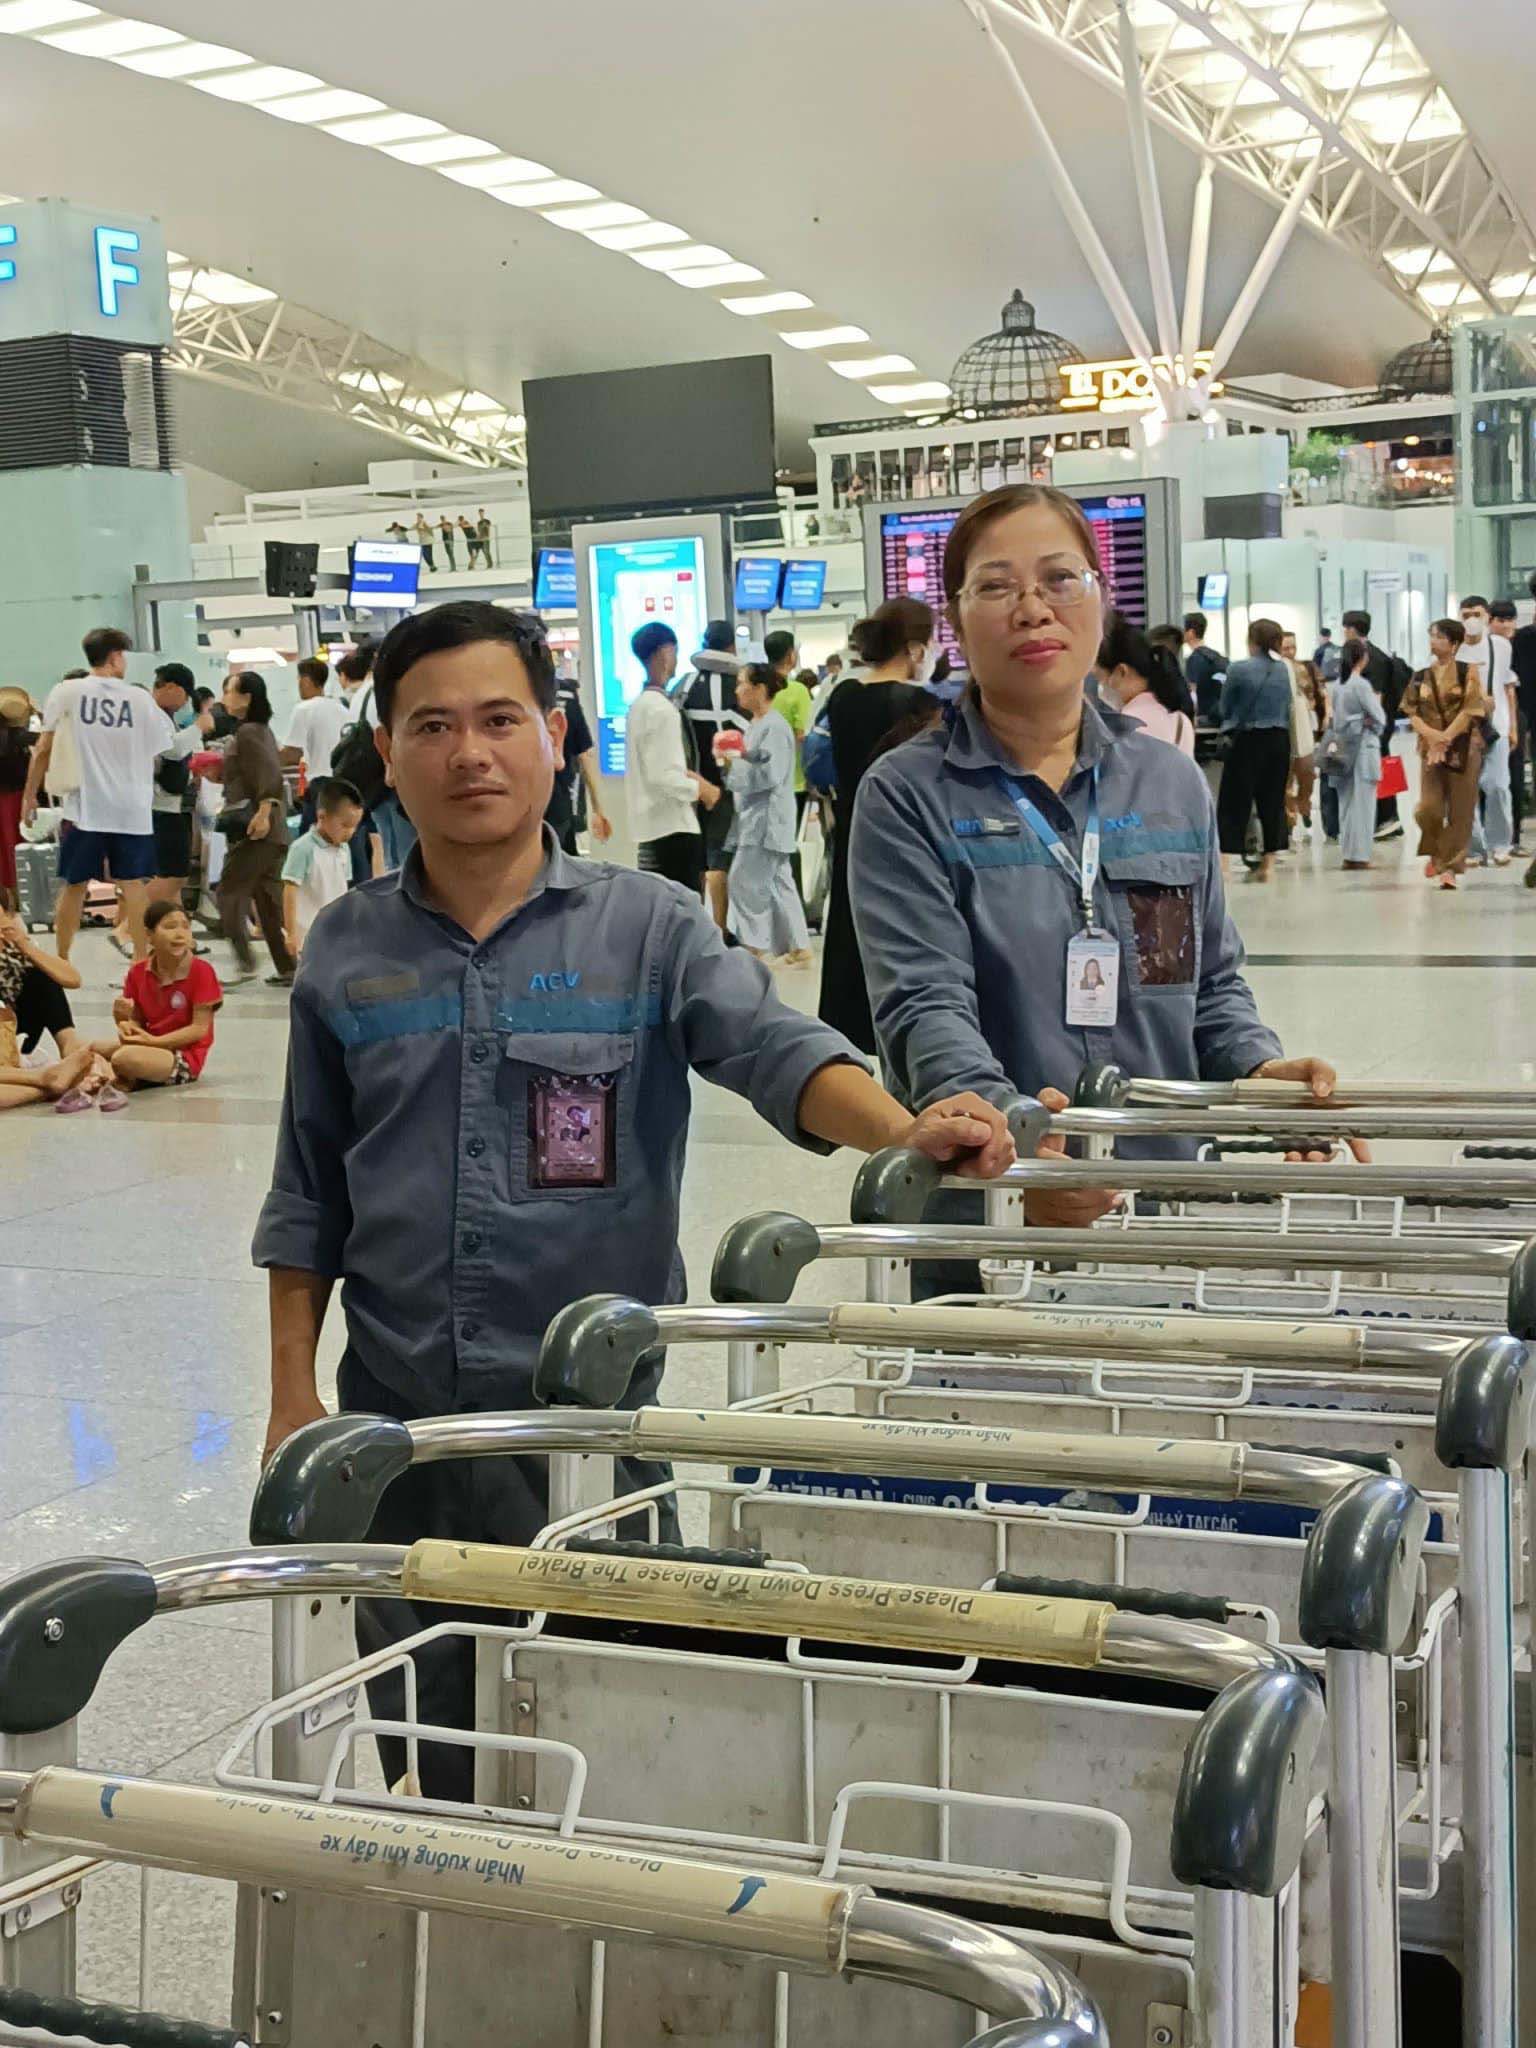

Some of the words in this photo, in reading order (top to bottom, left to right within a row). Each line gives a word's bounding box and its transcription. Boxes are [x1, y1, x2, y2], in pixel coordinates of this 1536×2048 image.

[95, 226, 139, 316] F
[80, 695, 133, 728] USA
[518, 1555, 586, 1580] Brake!
[592, 1563, 627, 1583] The
[637, 1565, 721, 1591] Release
[728, 1574, 750, 1594] To
[760, 1575, 822, 1600] Down
[828, 1582, 891, 1607] Press
[900, 1589, 974, 1615] Please
[320, 1833, 343, 1852] xe
[382, 1843, 410, 1868] khi
[414, 1844, 471, 1875] xuống
[475, 1857, 525, 1885] Nhấn
